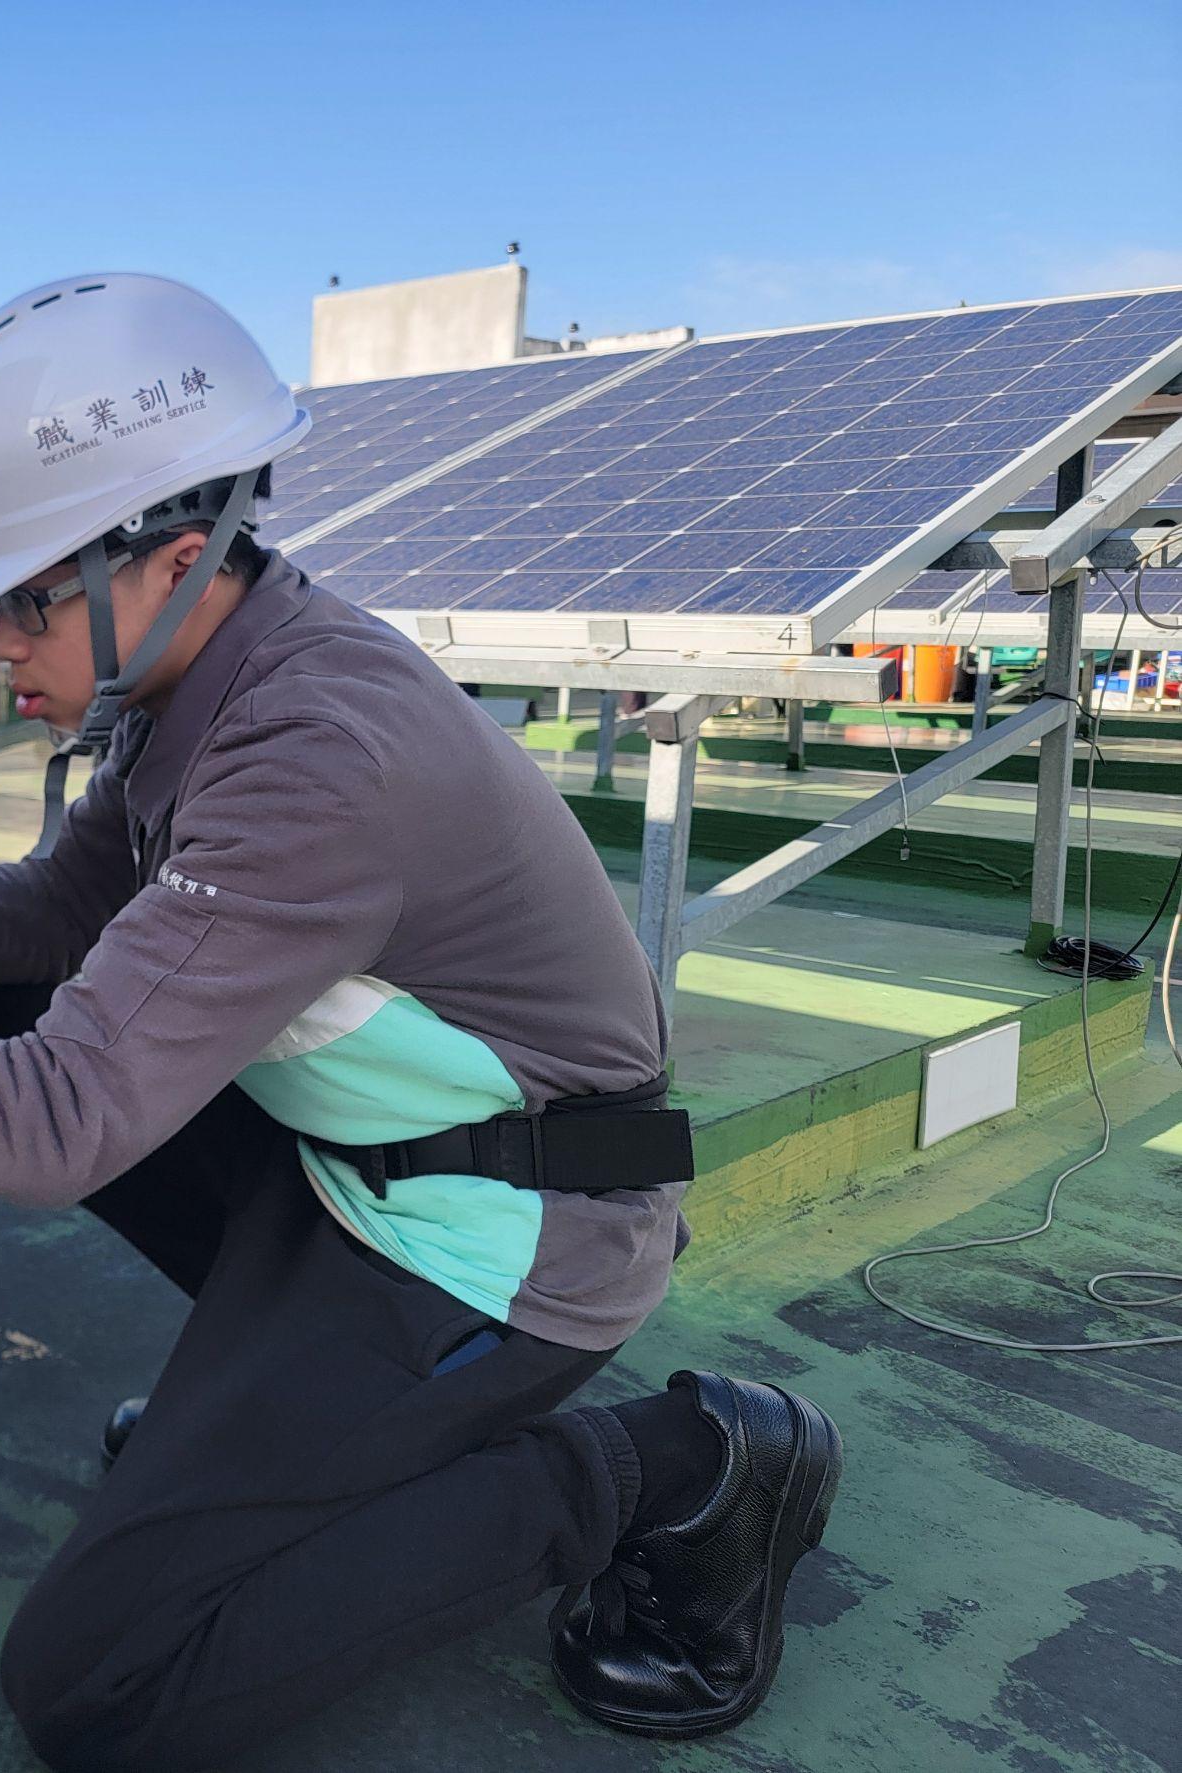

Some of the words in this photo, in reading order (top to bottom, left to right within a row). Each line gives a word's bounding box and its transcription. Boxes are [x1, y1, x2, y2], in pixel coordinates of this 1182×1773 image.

[34, 366, 215, 451] 職業訓練
[41, 437, 103, 467] VOCATIONAL
[113, 413, 162, 440] TRAINING
[166, 398, 207, 421] SERVICE
[777, 623, 798, 650] 4
